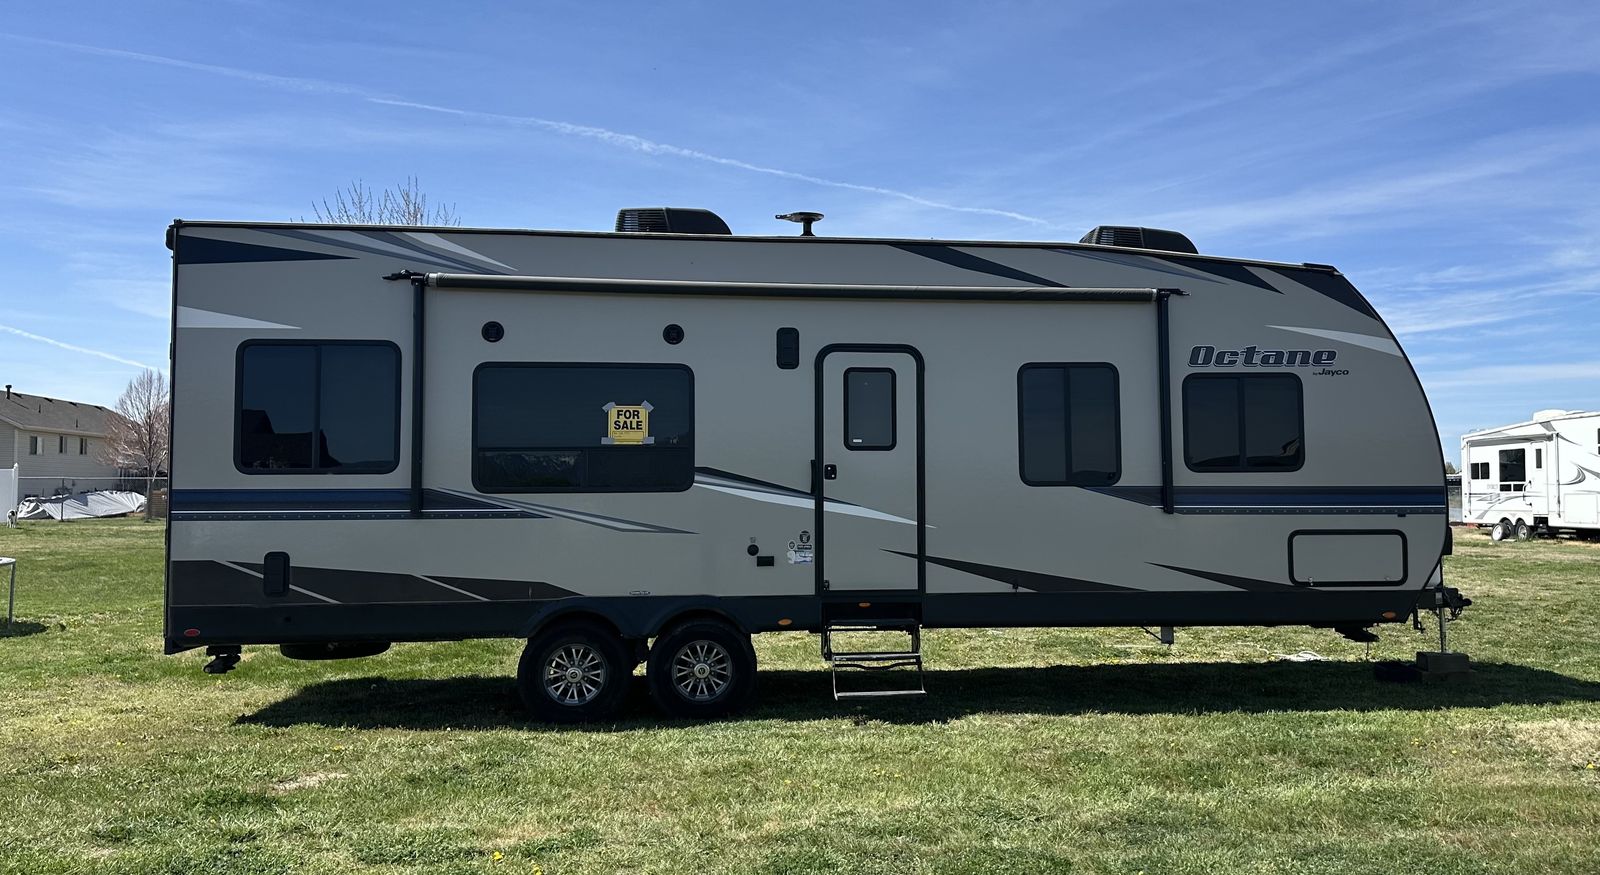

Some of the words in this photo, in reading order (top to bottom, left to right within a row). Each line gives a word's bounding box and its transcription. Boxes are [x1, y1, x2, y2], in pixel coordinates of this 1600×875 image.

[1188, 345, 1337, 367] Octane
[1318, 368, 1350, 377] Jayco
[616, 409, 640, 420] FOR
[613, 420, 643, 431] SALE
